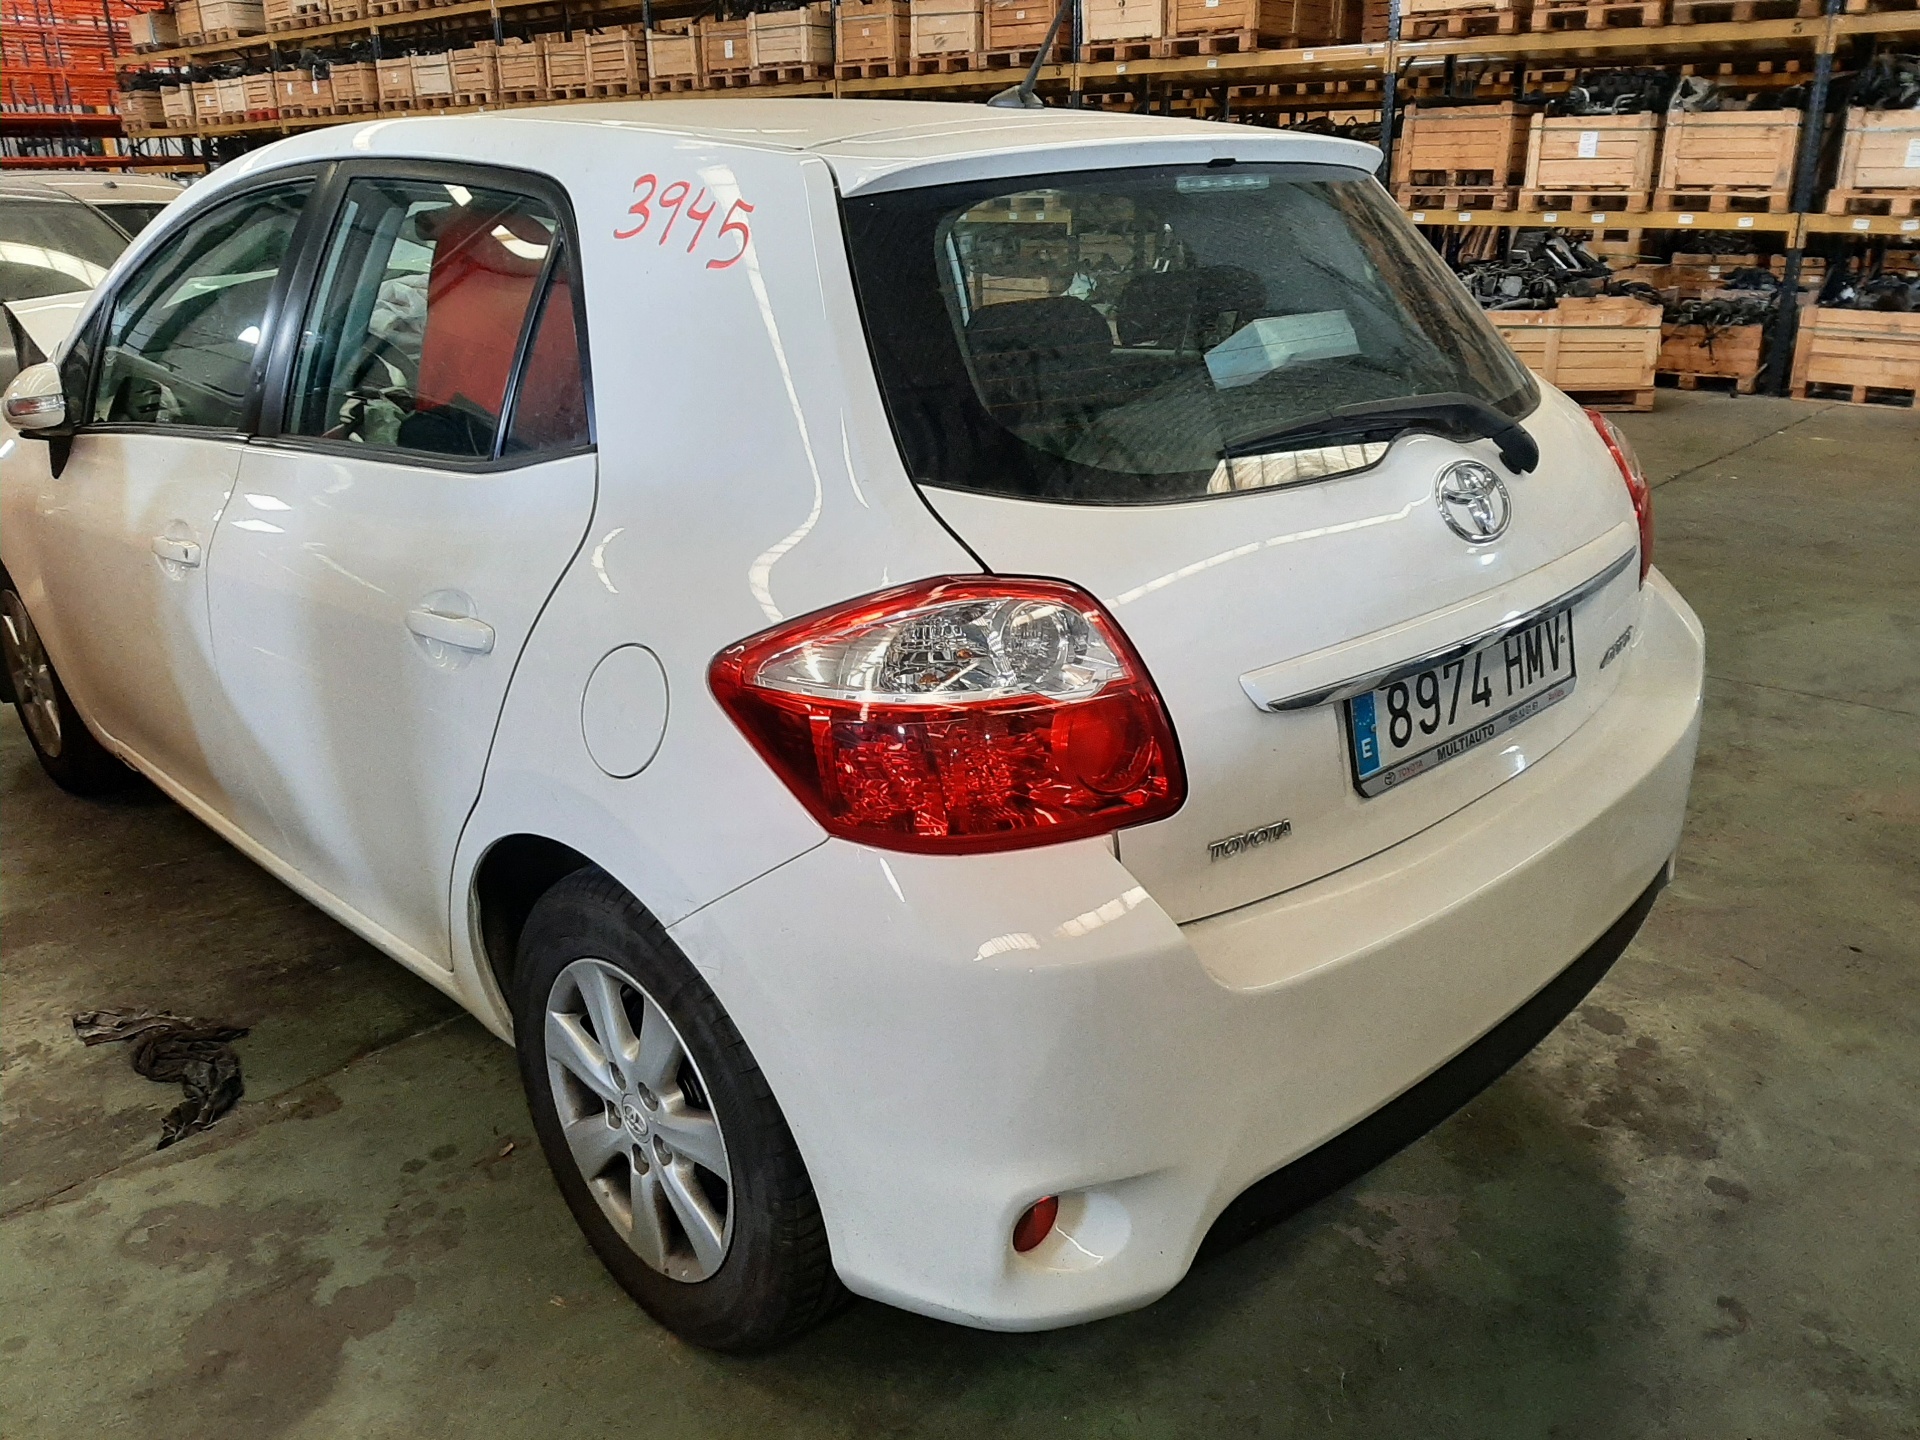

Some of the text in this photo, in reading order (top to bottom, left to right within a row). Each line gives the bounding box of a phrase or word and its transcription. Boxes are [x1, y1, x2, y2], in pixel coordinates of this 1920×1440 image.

[612, 173, 756, 270] 3945
[1386, 651, 1492, 748] 8974
[1503, 615, 1560, 696] HMV
[1361, 737, 1373, 759] E
[1436, 723, 1496, 761] MULTIAUTO
[1208, 818, 1292, 862] TOYOTA
